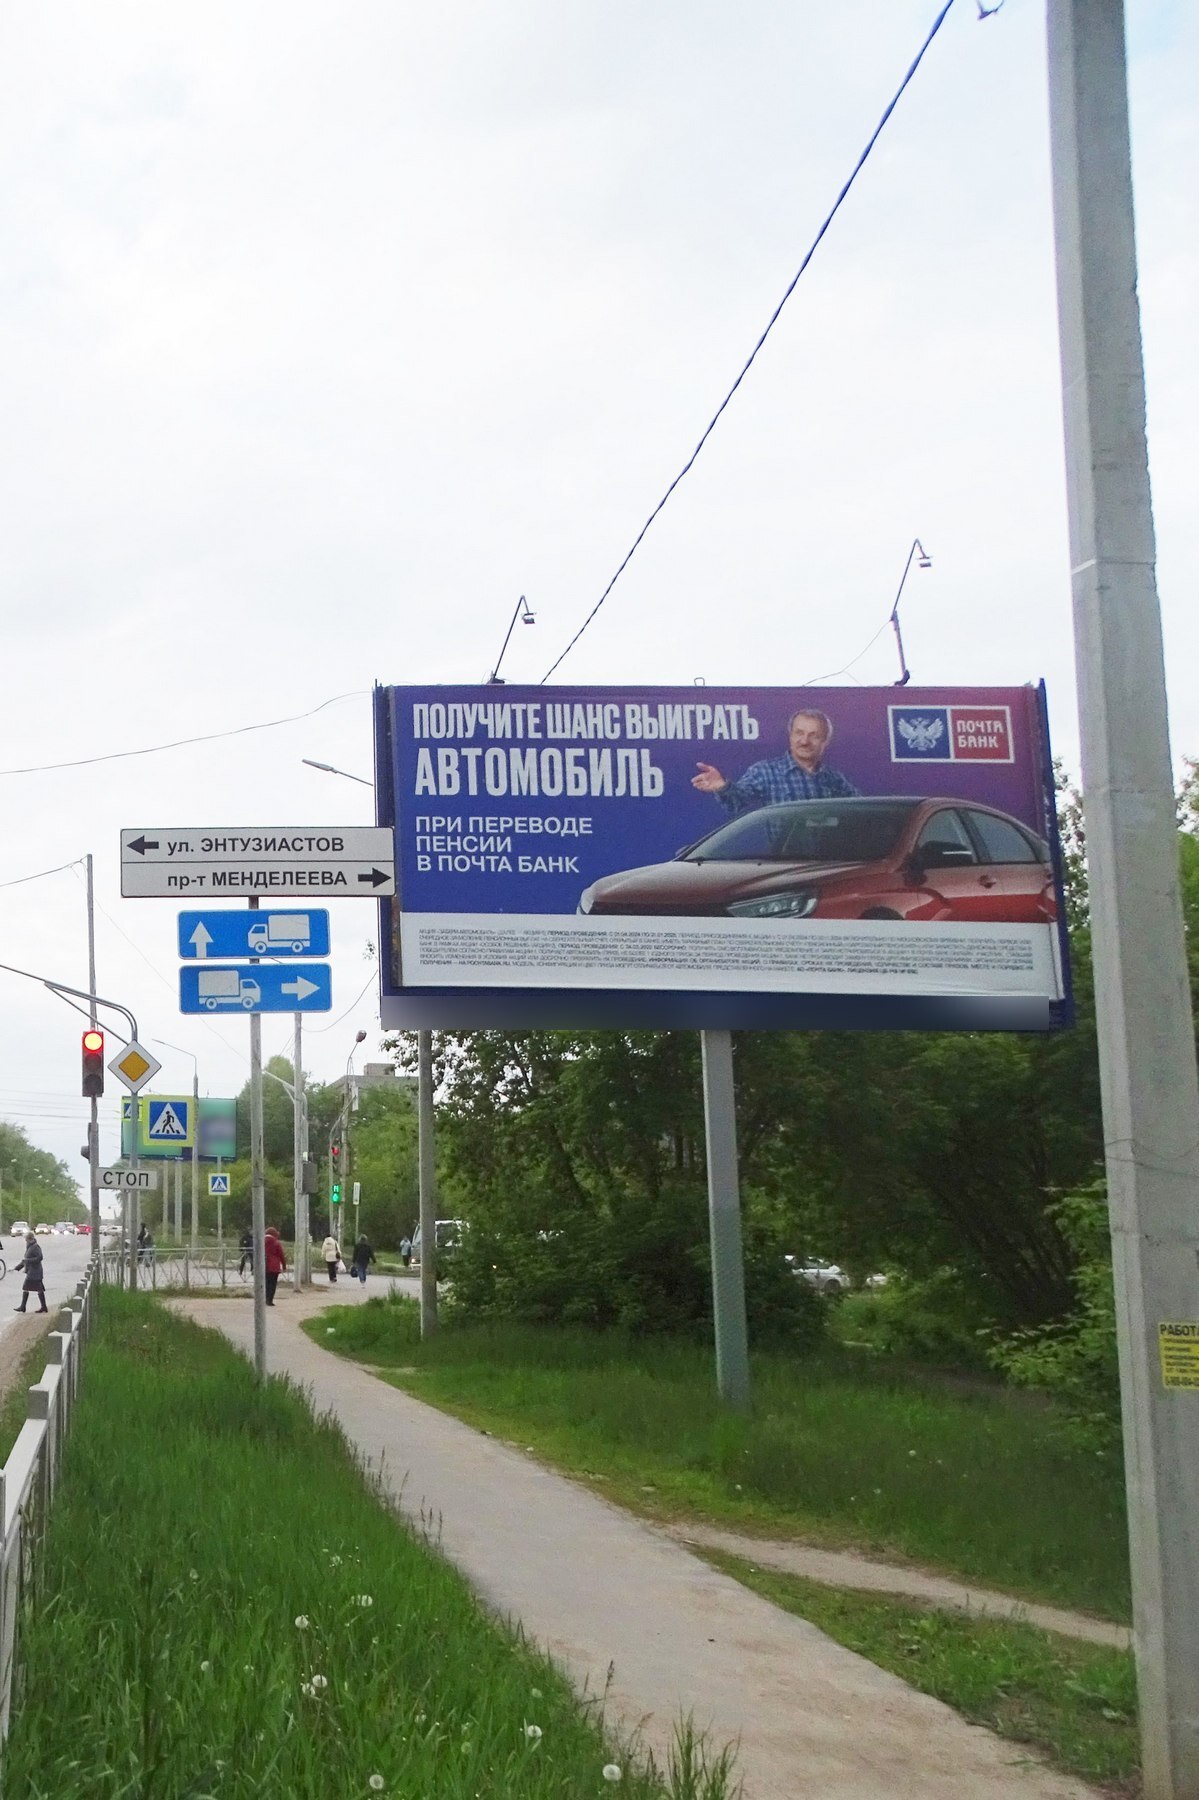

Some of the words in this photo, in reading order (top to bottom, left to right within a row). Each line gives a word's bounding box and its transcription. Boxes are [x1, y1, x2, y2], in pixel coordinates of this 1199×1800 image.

[412, 703, 542, 739] ПОЛУЧИТЕ
[546, 703, 620, 740] ШАНС
[624, 704, 760, 740] ВЫИГРАТЬ
[956, 720, 1003, 733] ПОЧТА
[958, 735, 999, 748] БАНК
[414, 747, 664, 797] АВТОМОБИЛЬ
[415, 816, 462, 833] ПРИ
[468, 816, 593, 837] ПЕРЕВОДЕ
[167, 841, 194, 856] ул.
[200, 837, 345, 852] ЭНТУЗИАСТОВ
[416, 835, 512, 853] ПЕНСИИ
[417, 855, 432, 871] В
[438, 855, 513, 872] ПОЧТА
[518, 856, 580, 873] БАНК
[167, 873, 206, 890] пр-т
[212, 871, 347, 888] МЕНДЕЛЕЕВА
[102, 1171, 149, 1187] СТОП
[1160, 1323, 1199, 1337] РАБОТ
